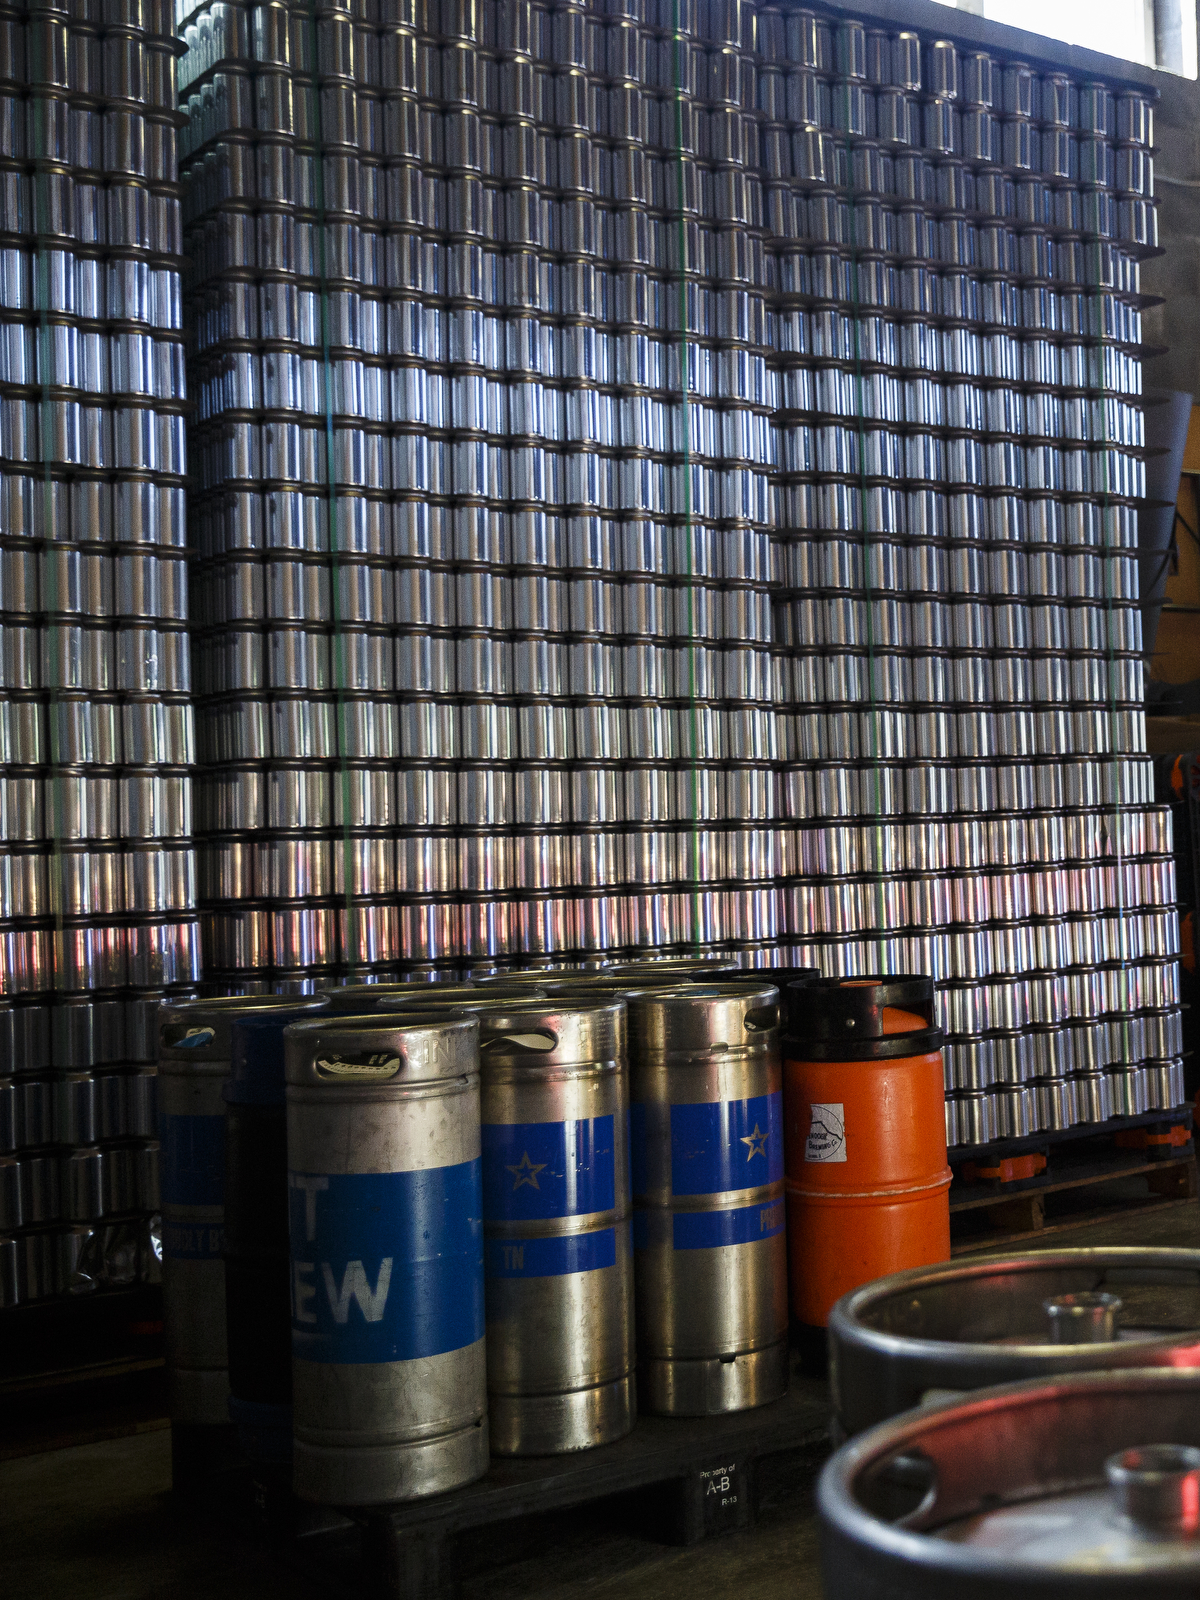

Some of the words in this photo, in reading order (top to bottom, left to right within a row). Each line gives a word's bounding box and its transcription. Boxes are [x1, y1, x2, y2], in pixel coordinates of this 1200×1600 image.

[291, 1175, 329, 1241] T
[291, 1257, 394, 1323] EW
[729, 1463, 736, 1472] of
[706, 1476, 730, 1495] A-B
[721, 1495, 738, 1506] R-13
